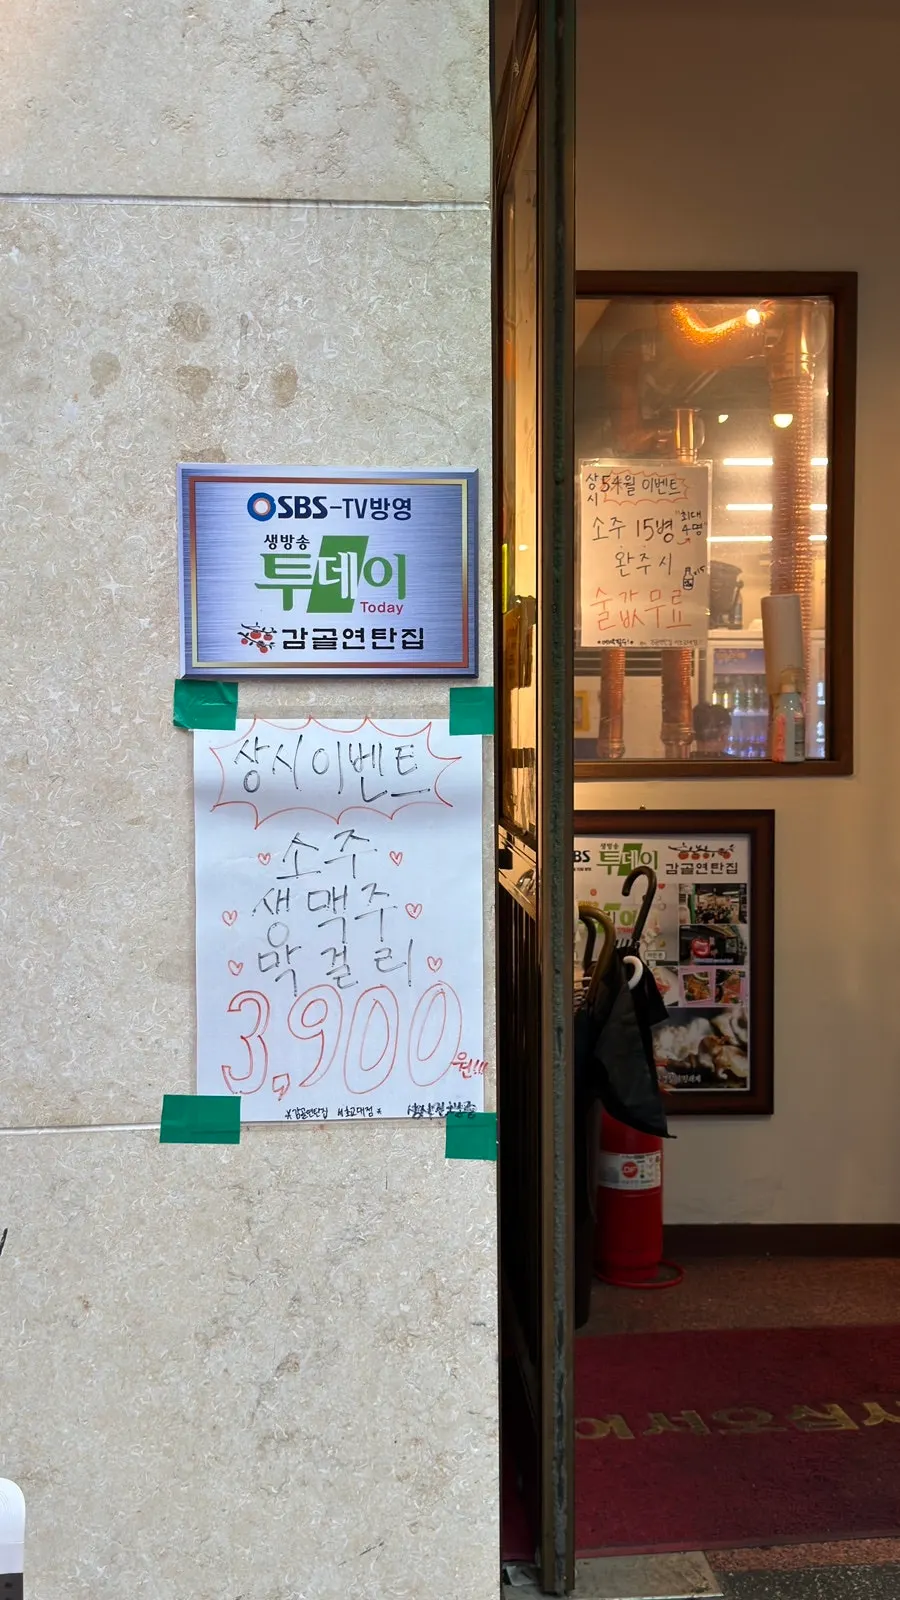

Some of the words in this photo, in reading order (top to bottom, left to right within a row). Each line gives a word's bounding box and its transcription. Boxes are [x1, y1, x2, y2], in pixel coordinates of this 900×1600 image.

[642, 478, 681, 496] 이벤트
[592, 516, 627, 541] 소주
[636, 517, 675, 543] 15병
[263, 533, 311, 551] 생방송
[254, 551, 406, 611] 투데이
[360, 601, 404, 615] Today
[282, 627, 425, 650] 감골연탄집
[276, 829, 378, 879] 소주
[573, 850, 591, 863] BS
[596, 849, 659, 875] 투데이
[665, 862, 739, 875] 감골연탄집
[252, 883, 398, 948] 생맥주
[258, 939, 414, 997] 막걸리
